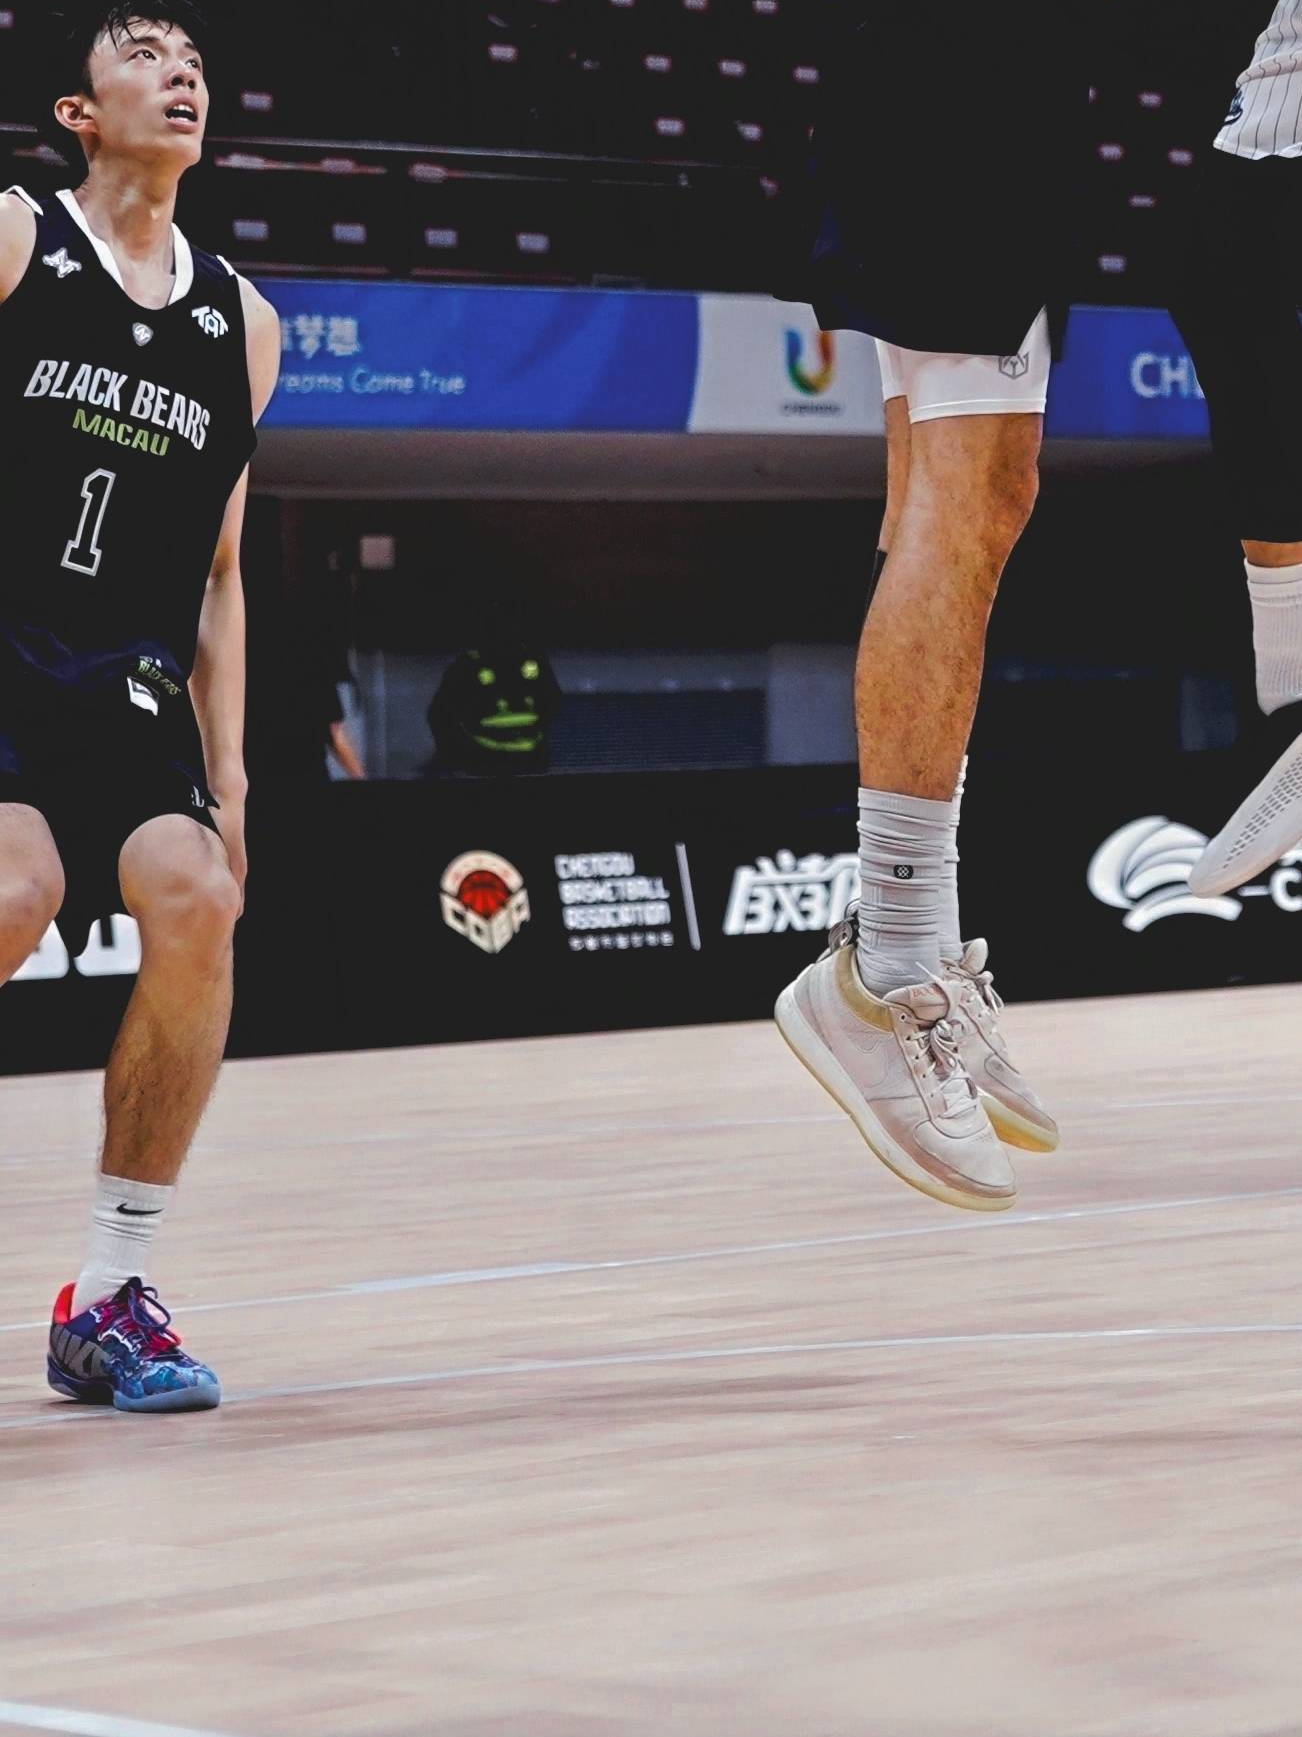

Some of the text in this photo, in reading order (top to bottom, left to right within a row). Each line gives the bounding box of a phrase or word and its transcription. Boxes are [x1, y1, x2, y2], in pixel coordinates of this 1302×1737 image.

[350, 365, 415, 395] Come
[419, 366, 467, 395] True
[24, 360, 211, 451] BLACK BEARS
[72, 409, 170, 457] MACAU
[60, 467, 117, 577] 1
[558, 876, 671, 905] BASKETBALL
[562, 900, 672, 931] ASSOCIATION
